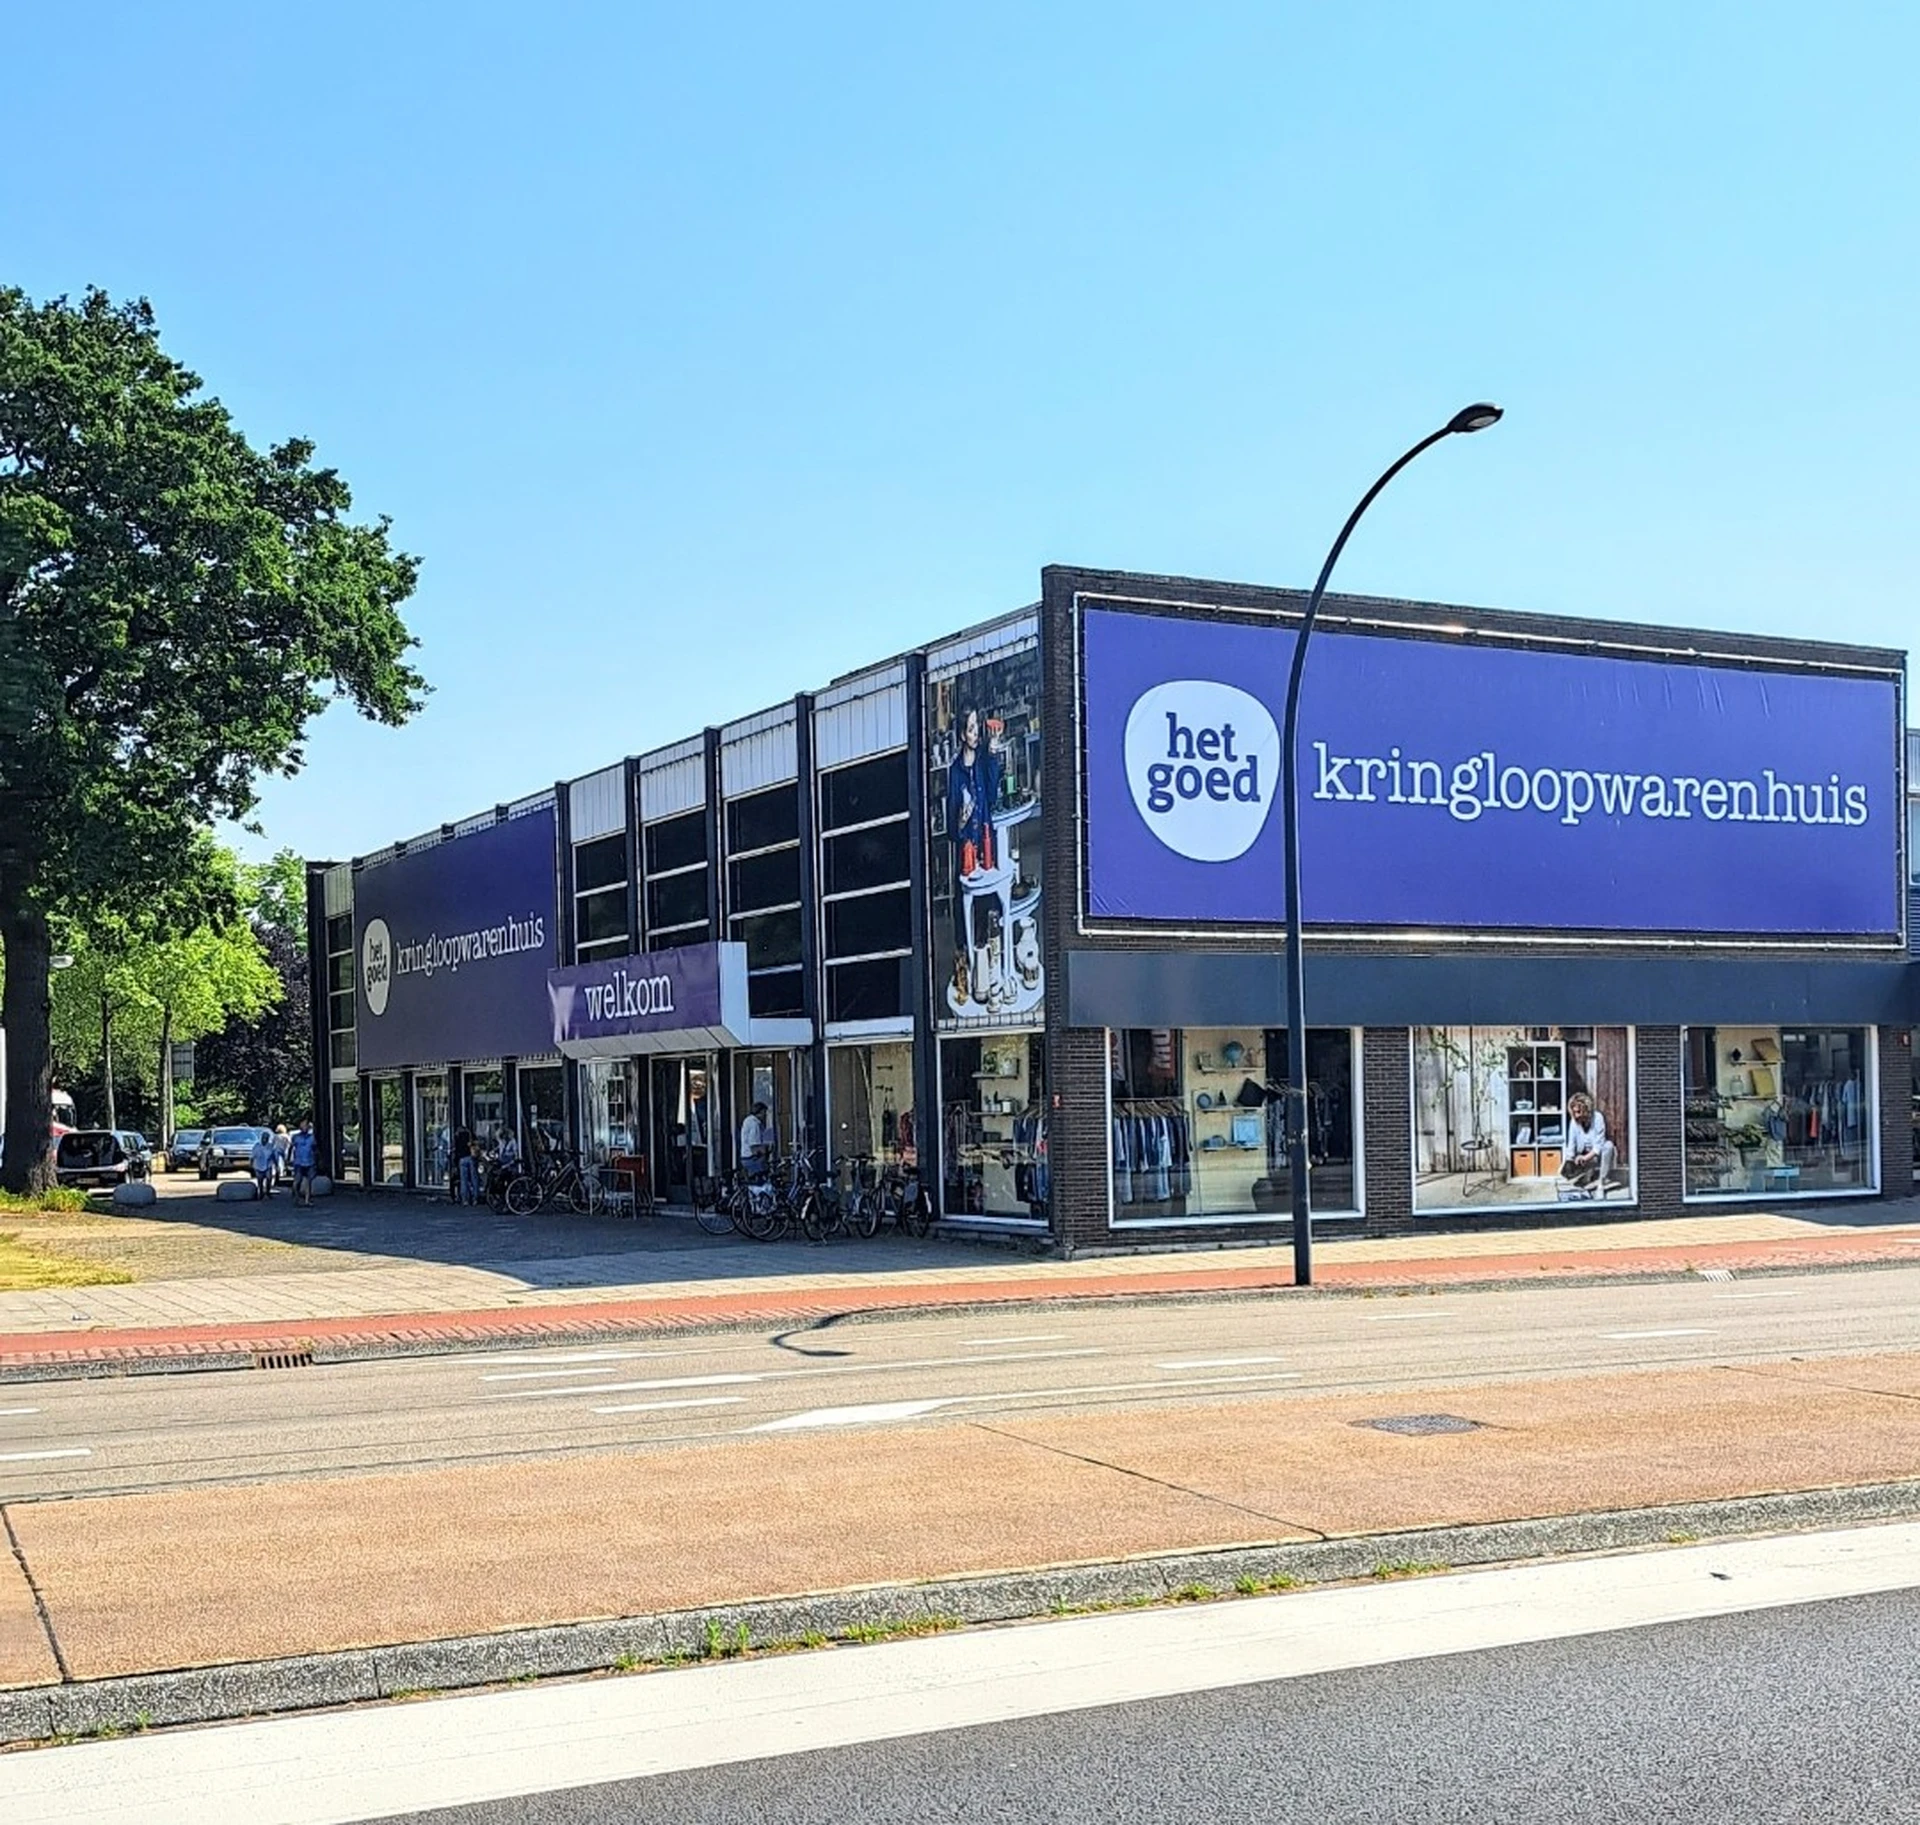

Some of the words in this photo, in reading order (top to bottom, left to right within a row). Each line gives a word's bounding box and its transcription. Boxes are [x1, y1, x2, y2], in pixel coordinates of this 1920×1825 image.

[1166, 711, 1238, 762] het
[1147, 755, 1260, 814] goed
[1313, 741, 1868, 826] kringloopwarenhuis
[369, 938, 383, 962] het
[396, 911, 545, 977] kringloopwarenhuis
[366, 954, 388, 993] goed
[584, 970, 674, 1021] welkom
